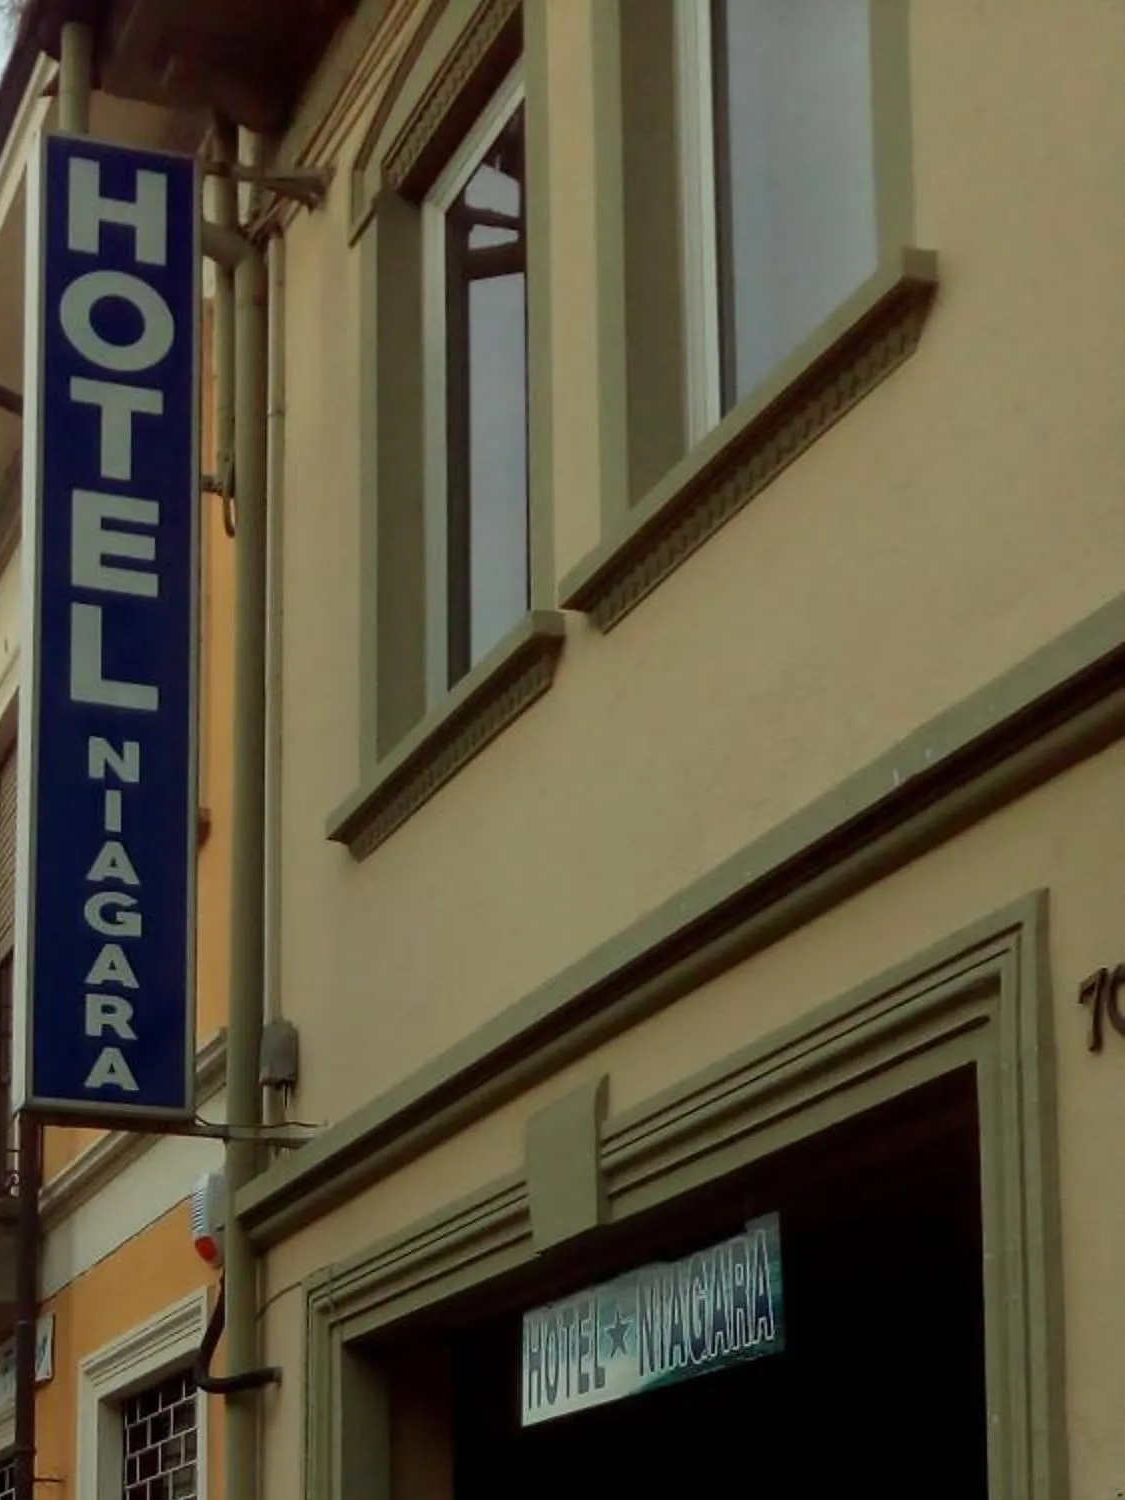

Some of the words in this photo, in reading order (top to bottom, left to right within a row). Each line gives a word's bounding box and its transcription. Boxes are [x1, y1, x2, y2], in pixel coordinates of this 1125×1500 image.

[59, 156, 175, 712] HOTEL
[83, 735, 142, 1092] NIAGARA
[524, 1297, 606, 1410] HOTEL
[636, 1229, 774, 1377] NIAGARA
